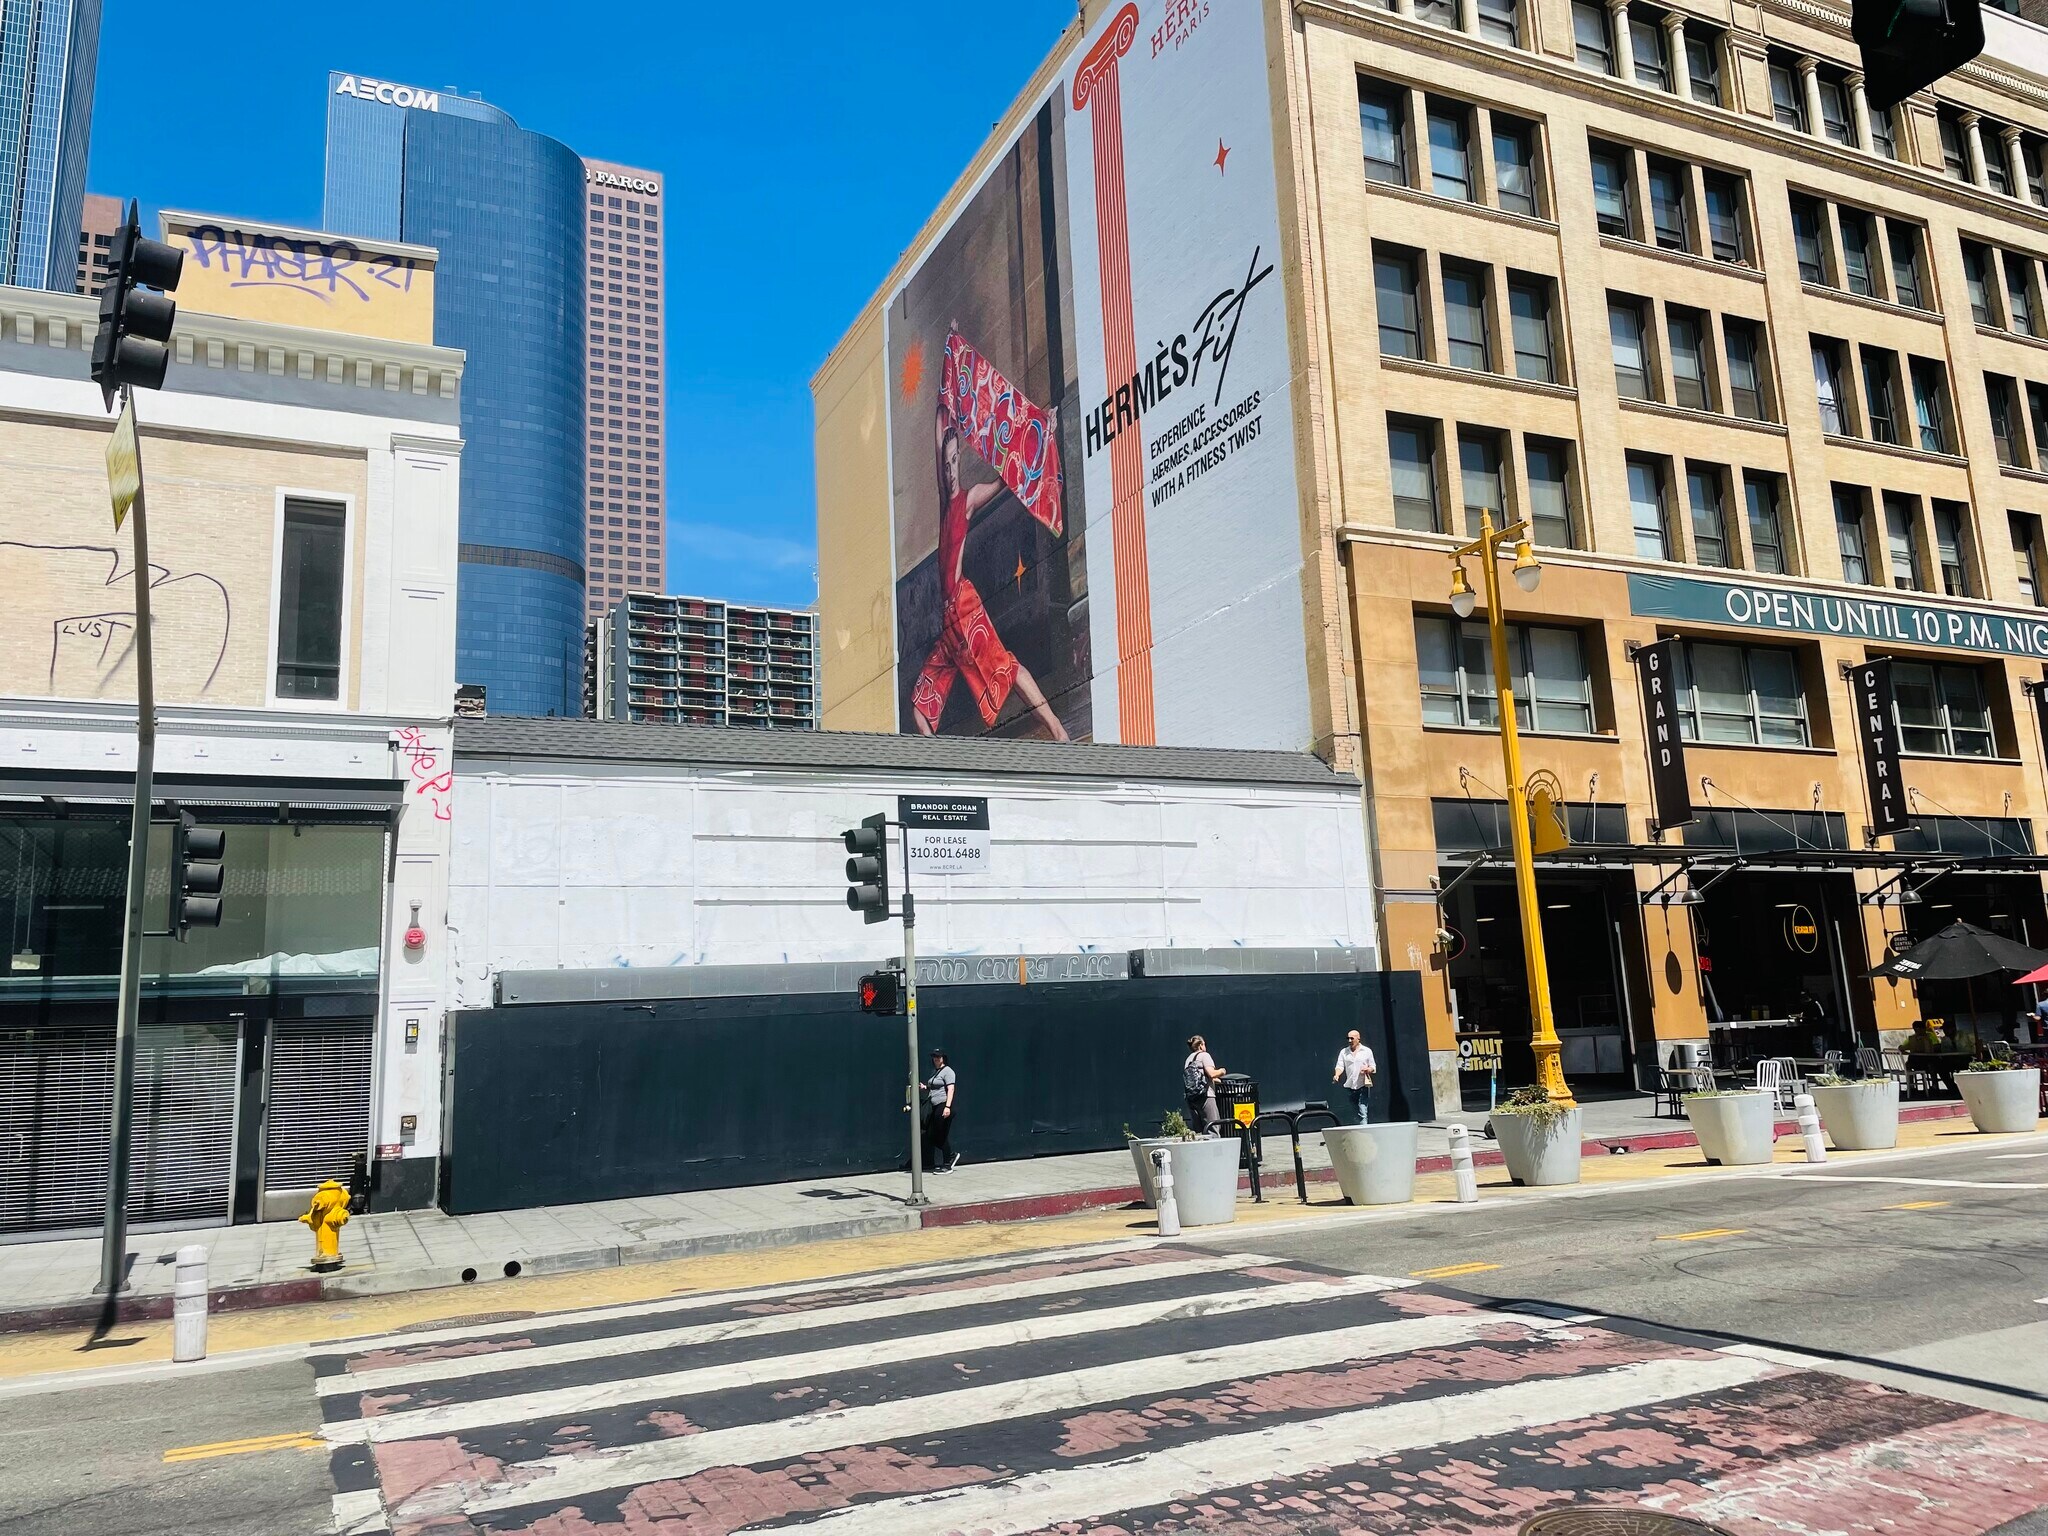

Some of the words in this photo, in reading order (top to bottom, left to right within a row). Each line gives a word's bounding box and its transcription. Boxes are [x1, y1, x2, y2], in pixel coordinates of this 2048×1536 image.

[1175, 1, 1210, 51] PARIS
[336, 75, 439, 112] AECOM
[596, 170, 659, 194] FARGO
[1085, 333, 1190, 459] HERMÈS
[1150, 403, 1206, 460] EXPERIENCE
[1193, 390, 1261, 453] ACCESSORIES
[1151, 477, 1176, 508] WITH
[1178, 472, 1185, 492] A
[1187, 441, 1227, 485] FITNESS
[1227, 414, 1262, 455] TWIST
[1725, 588, 1816, 630] OPEN
[1822, 599, 1909, 640] UNTIL
[1911, 609, 1941, 643] 10
[1947, 612, 2000, 650] P.M.
[1648, 651, 1672, 768] GRAND
[1864, 669, 1896, 824] CENTRAL
[910, 803, 949, 811] BRANDON
[951, 803, 978, 812] COHAN
[943, 814, 968, 822] ESTATE
[910, 847, 981, 859] 310.801.6488
[924, 836, 941, 844] FOR
[943, 836, 967, 845] LEASE
[1456, 1038, 1503, 1057] ONUT
